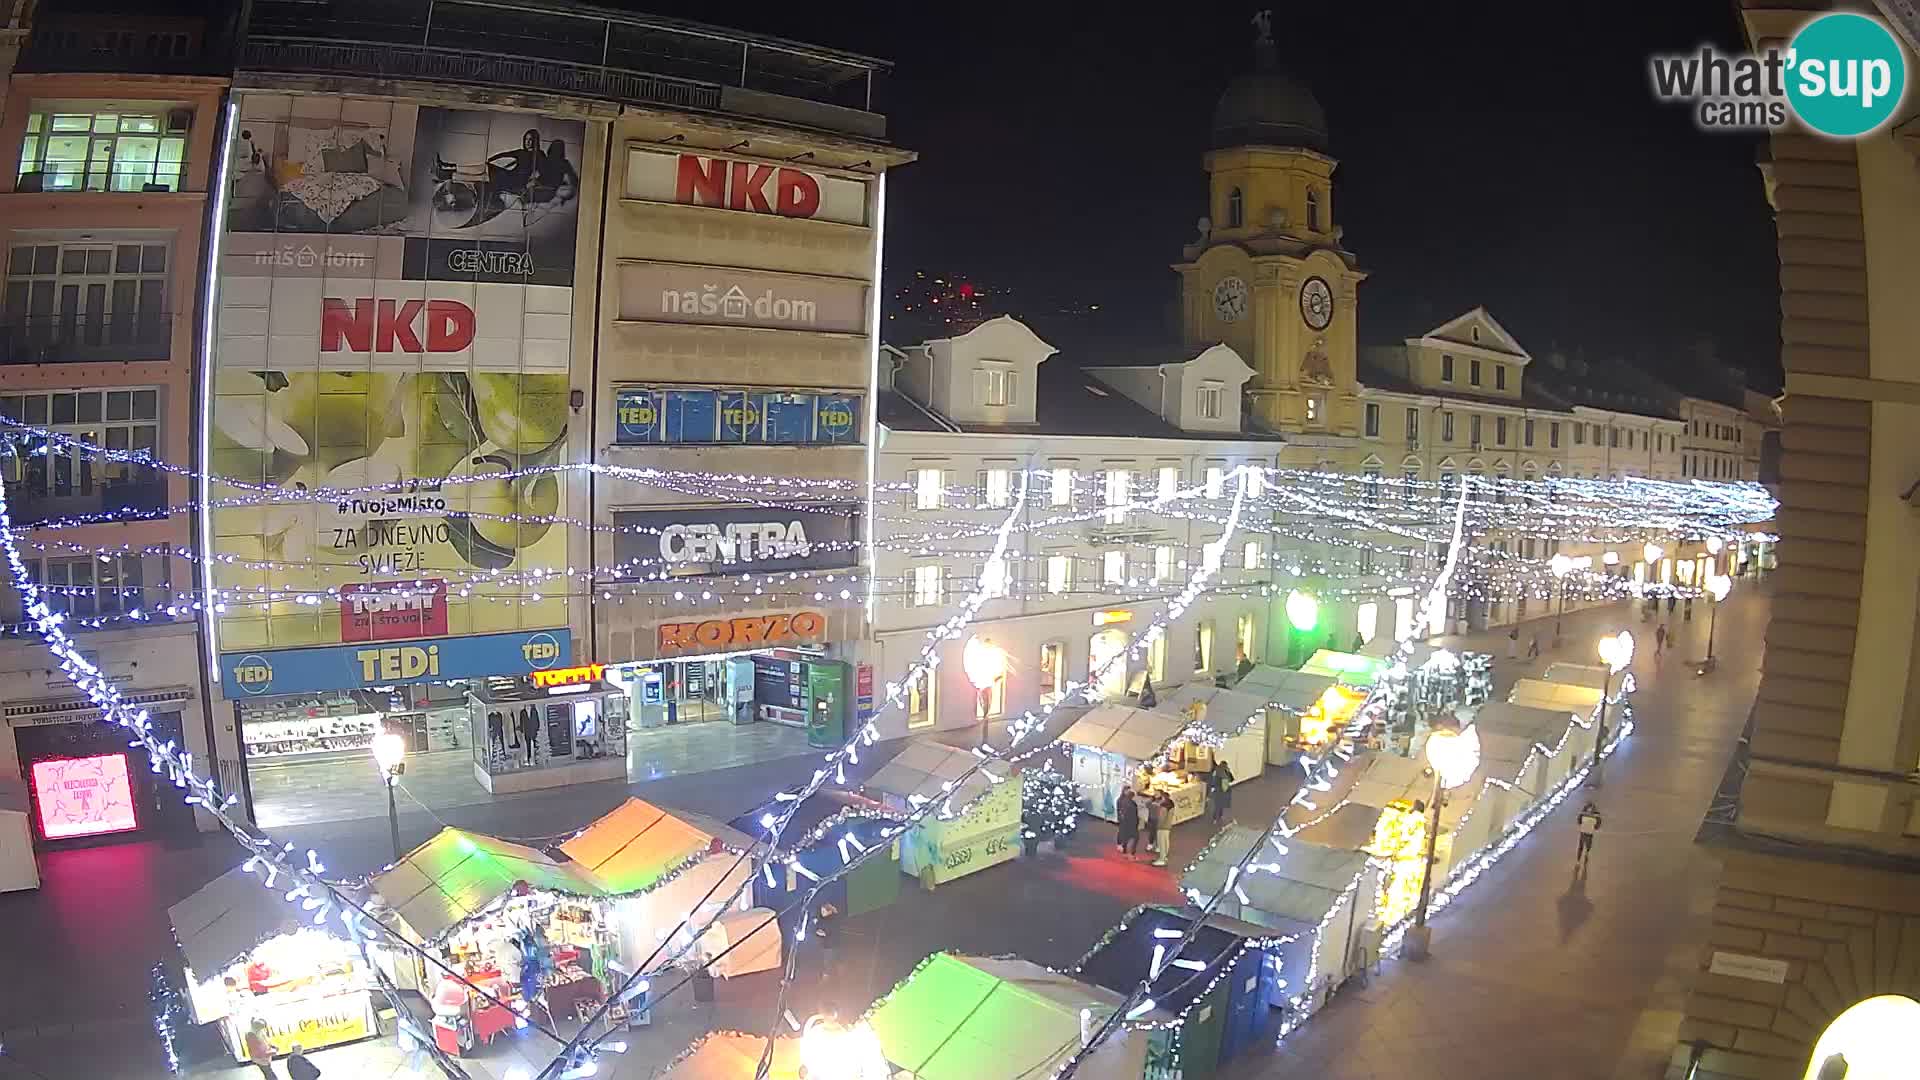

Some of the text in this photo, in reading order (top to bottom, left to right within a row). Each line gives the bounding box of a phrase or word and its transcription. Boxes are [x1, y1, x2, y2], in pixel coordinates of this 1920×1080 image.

[675, 153, 821, 219] NKD
[320, 245, 366, 267] dom
[447, 249, 535, 275] CENTRA
[661, 284, 817, 323] naš dom
[320, 297, 477, 353] NKD
[333, 523, 450, 548] ZA DNEVNO
[659, 520, 811, 563] CENTRA
[659, 612, 826, 649] KORZO
[357, 645, 439, 681] TEDi
[522, 643, 560, 661] TEDi
[234, 665, 272, 683] TEDi
[531, 664, 603, 688] TOMMY
